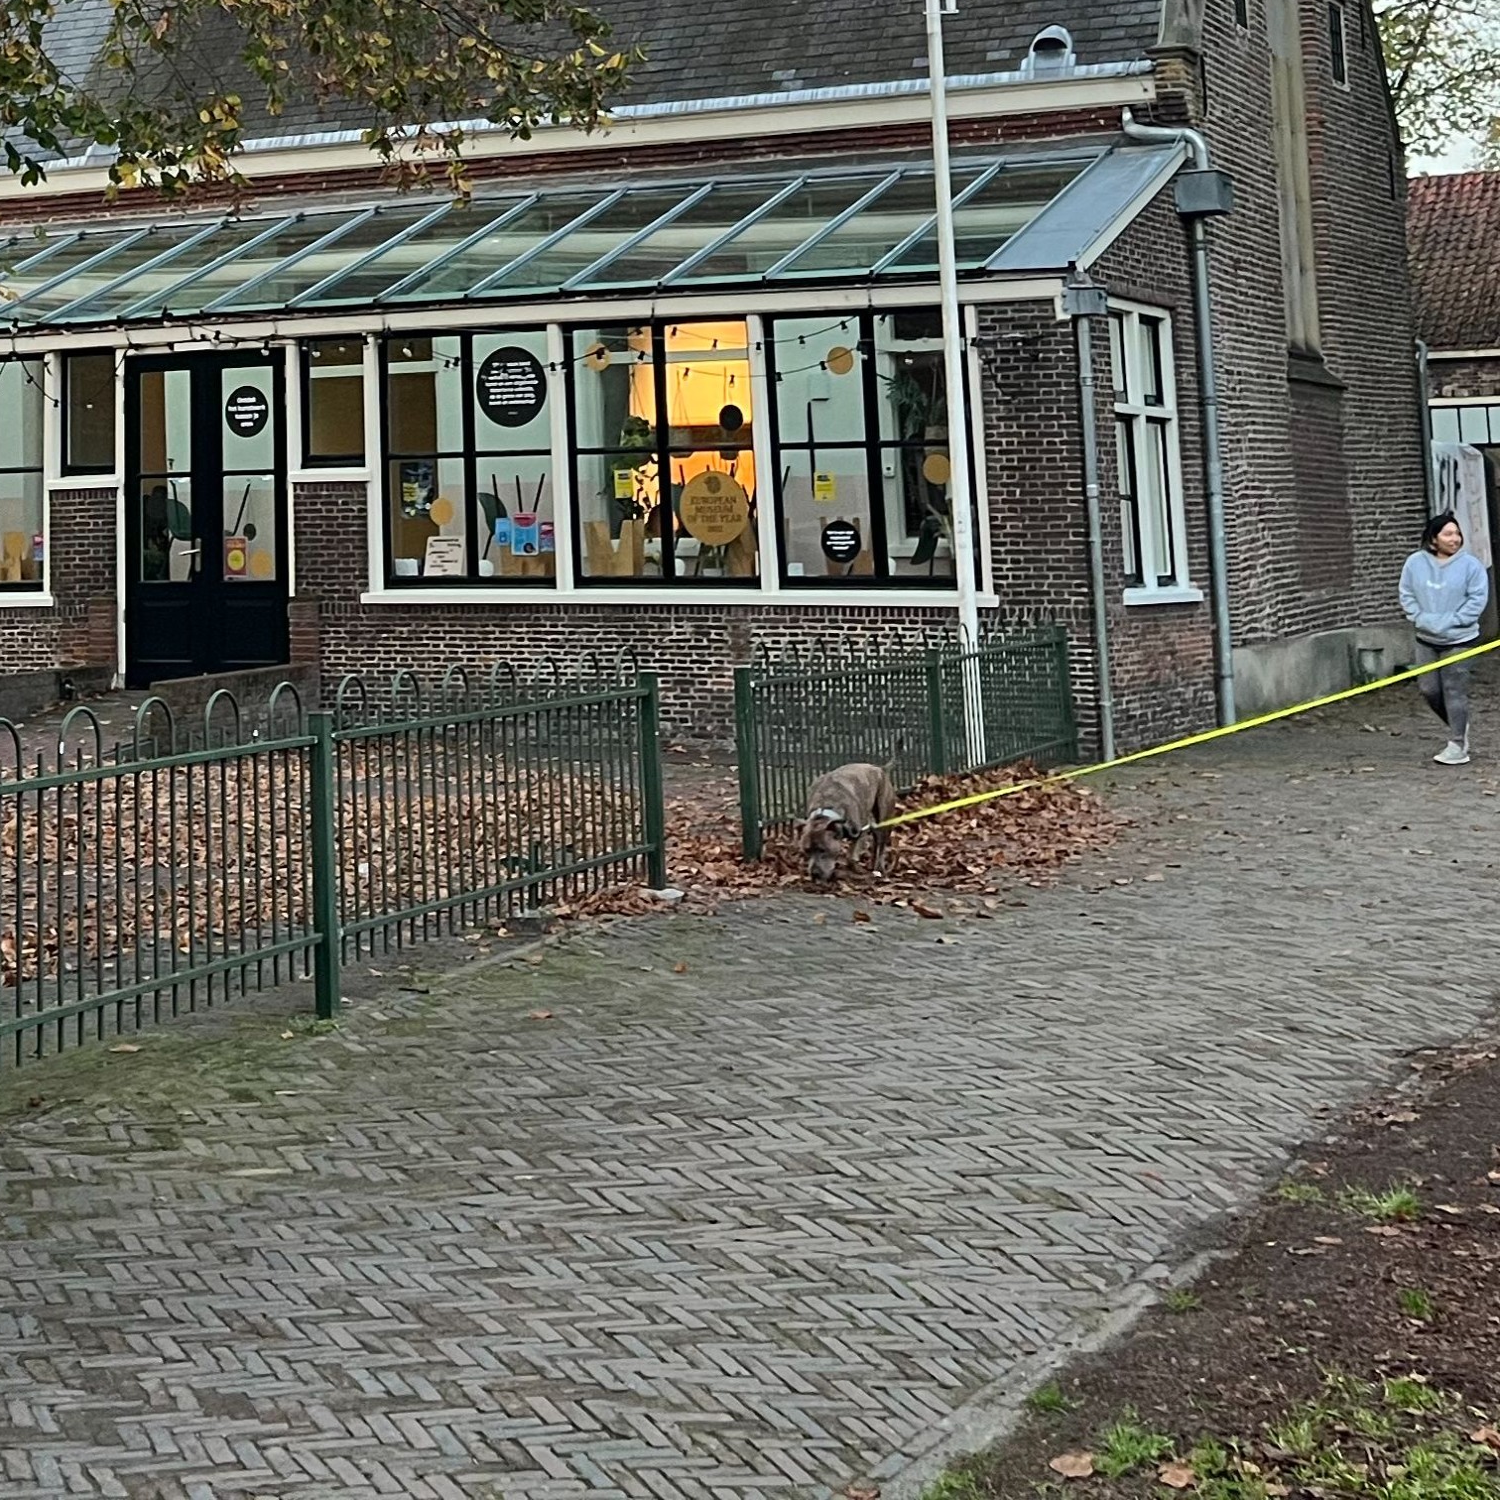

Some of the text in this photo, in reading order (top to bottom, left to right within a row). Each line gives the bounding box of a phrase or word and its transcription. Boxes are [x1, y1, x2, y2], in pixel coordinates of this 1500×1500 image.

[690, 496, 736, 505] EUROPEAN
[701, 514, 719, 522] THE
[720, 514, 742, 522] YEAR
